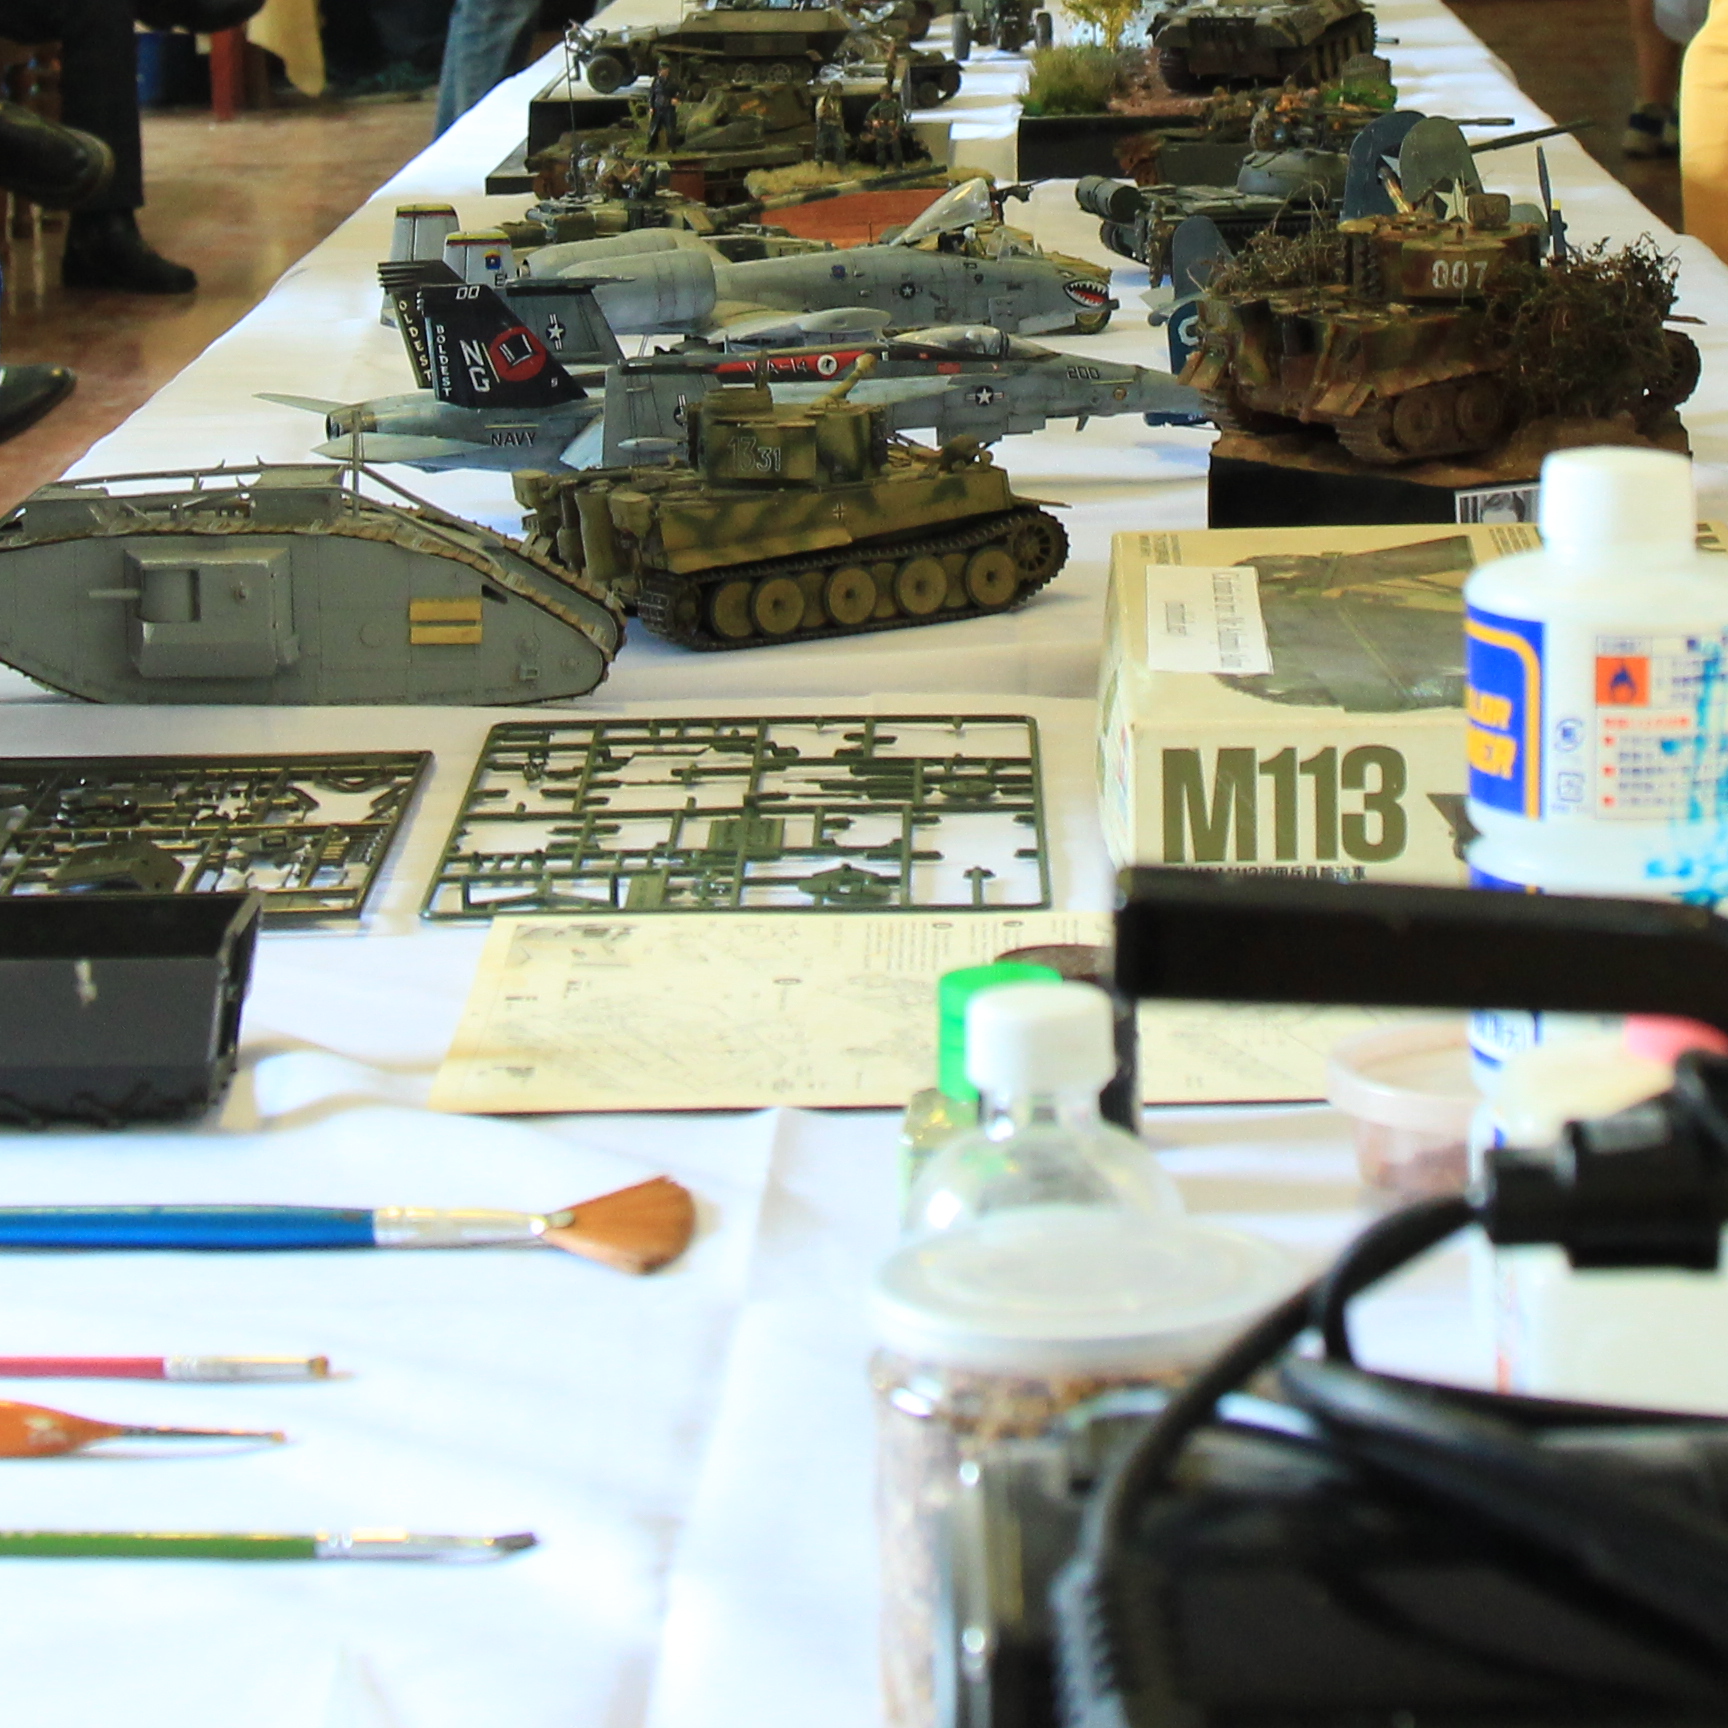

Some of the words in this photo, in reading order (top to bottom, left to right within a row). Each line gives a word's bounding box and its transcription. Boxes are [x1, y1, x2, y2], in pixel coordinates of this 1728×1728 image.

[1432, 259, 1489, 290] 007
[398, 299, 433, 382] OLDEST
[435, 324, 453, 398] BOLDEST
[1067, 365, 1101, 380] 200
[491, 431, 537, 447] NAVY
[1162, 745, 1408, 864] M113
